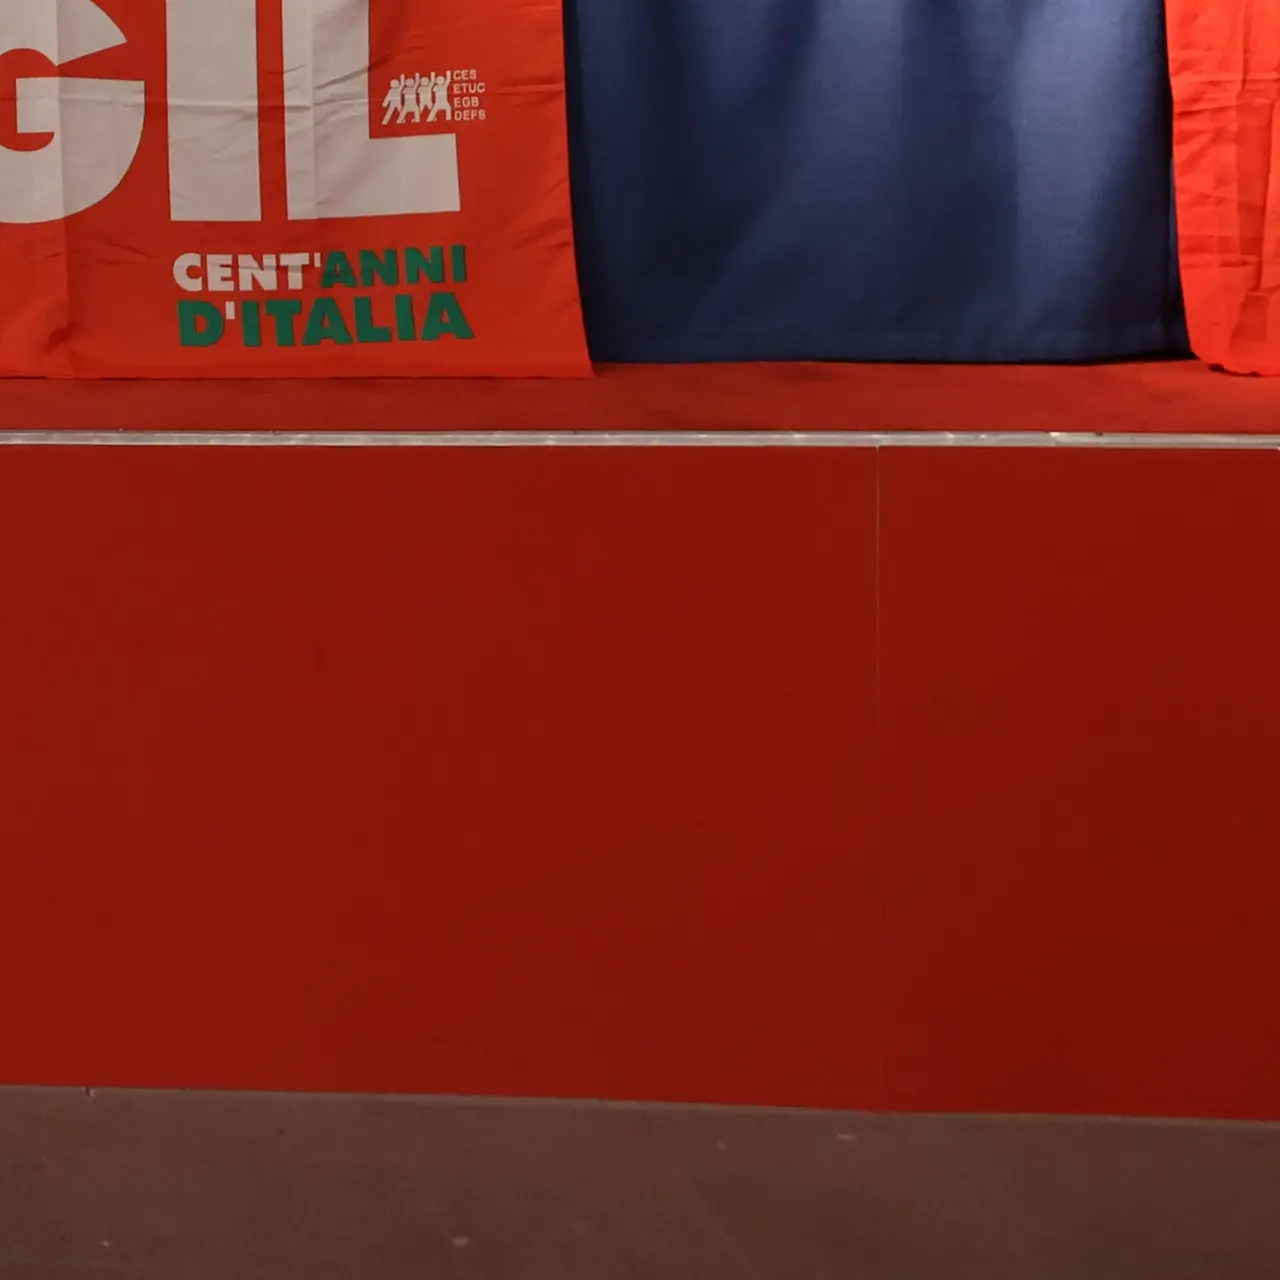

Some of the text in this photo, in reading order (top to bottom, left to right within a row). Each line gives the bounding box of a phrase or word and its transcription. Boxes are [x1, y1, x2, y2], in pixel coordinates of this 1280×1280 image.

[453, 69, 477, 80] CES
[453, 82, 486, 94] ETUC
[454, 96, 480, 108] EGB
[454, 109, 487, 121] DEFS
[176, 292, 476, 347] D'ITALIA
